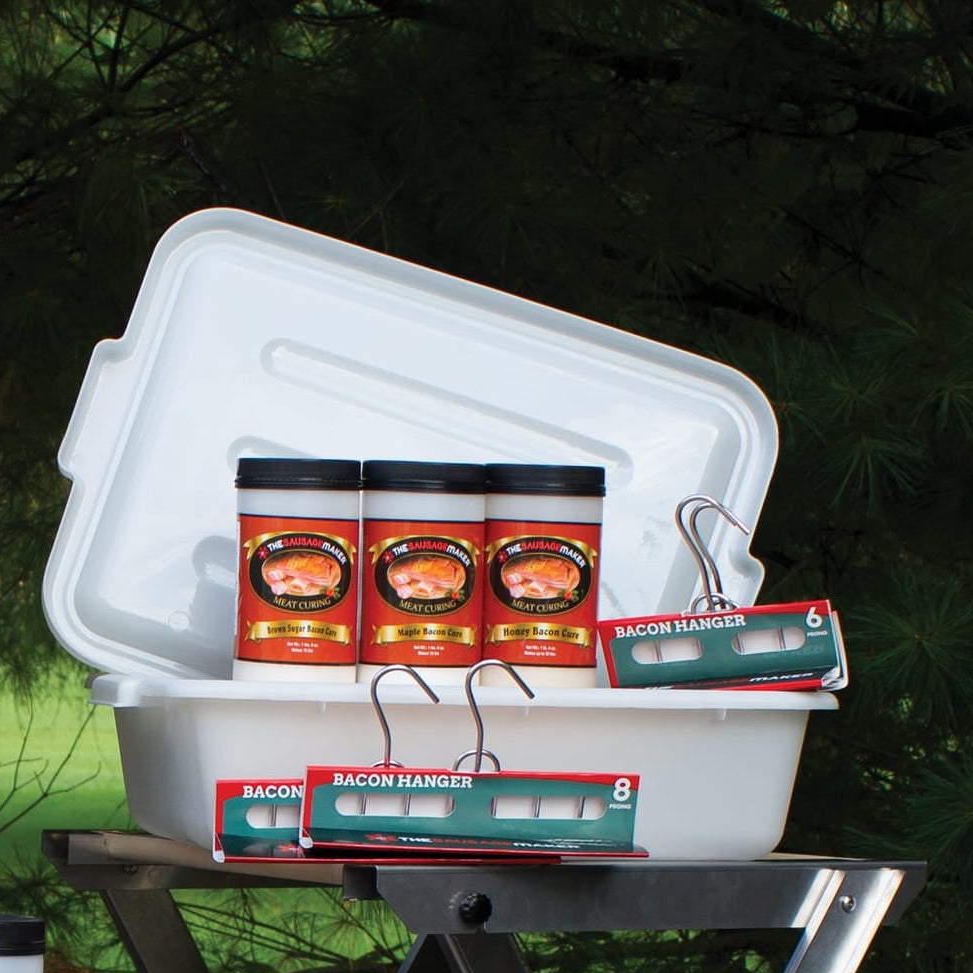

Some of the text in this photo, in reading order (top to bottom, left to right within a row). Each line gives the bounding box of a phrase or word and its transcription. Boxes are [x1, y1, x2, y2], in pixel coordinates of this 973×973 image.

[273, 596, 331, 610] MEAT CURING
[399, 599, 457, 613] MEAT CURING
[511, 599, 569, 613] MEAT CURING
[805, 606, 823, 629] 6
[267, 626, 287, 634] Brown
[287, 624, 306, 634] Sugar
[307, 625, 324, 634] Bacon
[397, 627, 463, 638] Maple Bacon Cure
[503, 626, 580, 640] Honey Bacon Cure
[614, 614, 747, 639] BACON HANGER
[332, 772, 473, 789] BACON HANGER
[242, 785, 304, 799] BACON
[612, 777, 632, 802] 8
